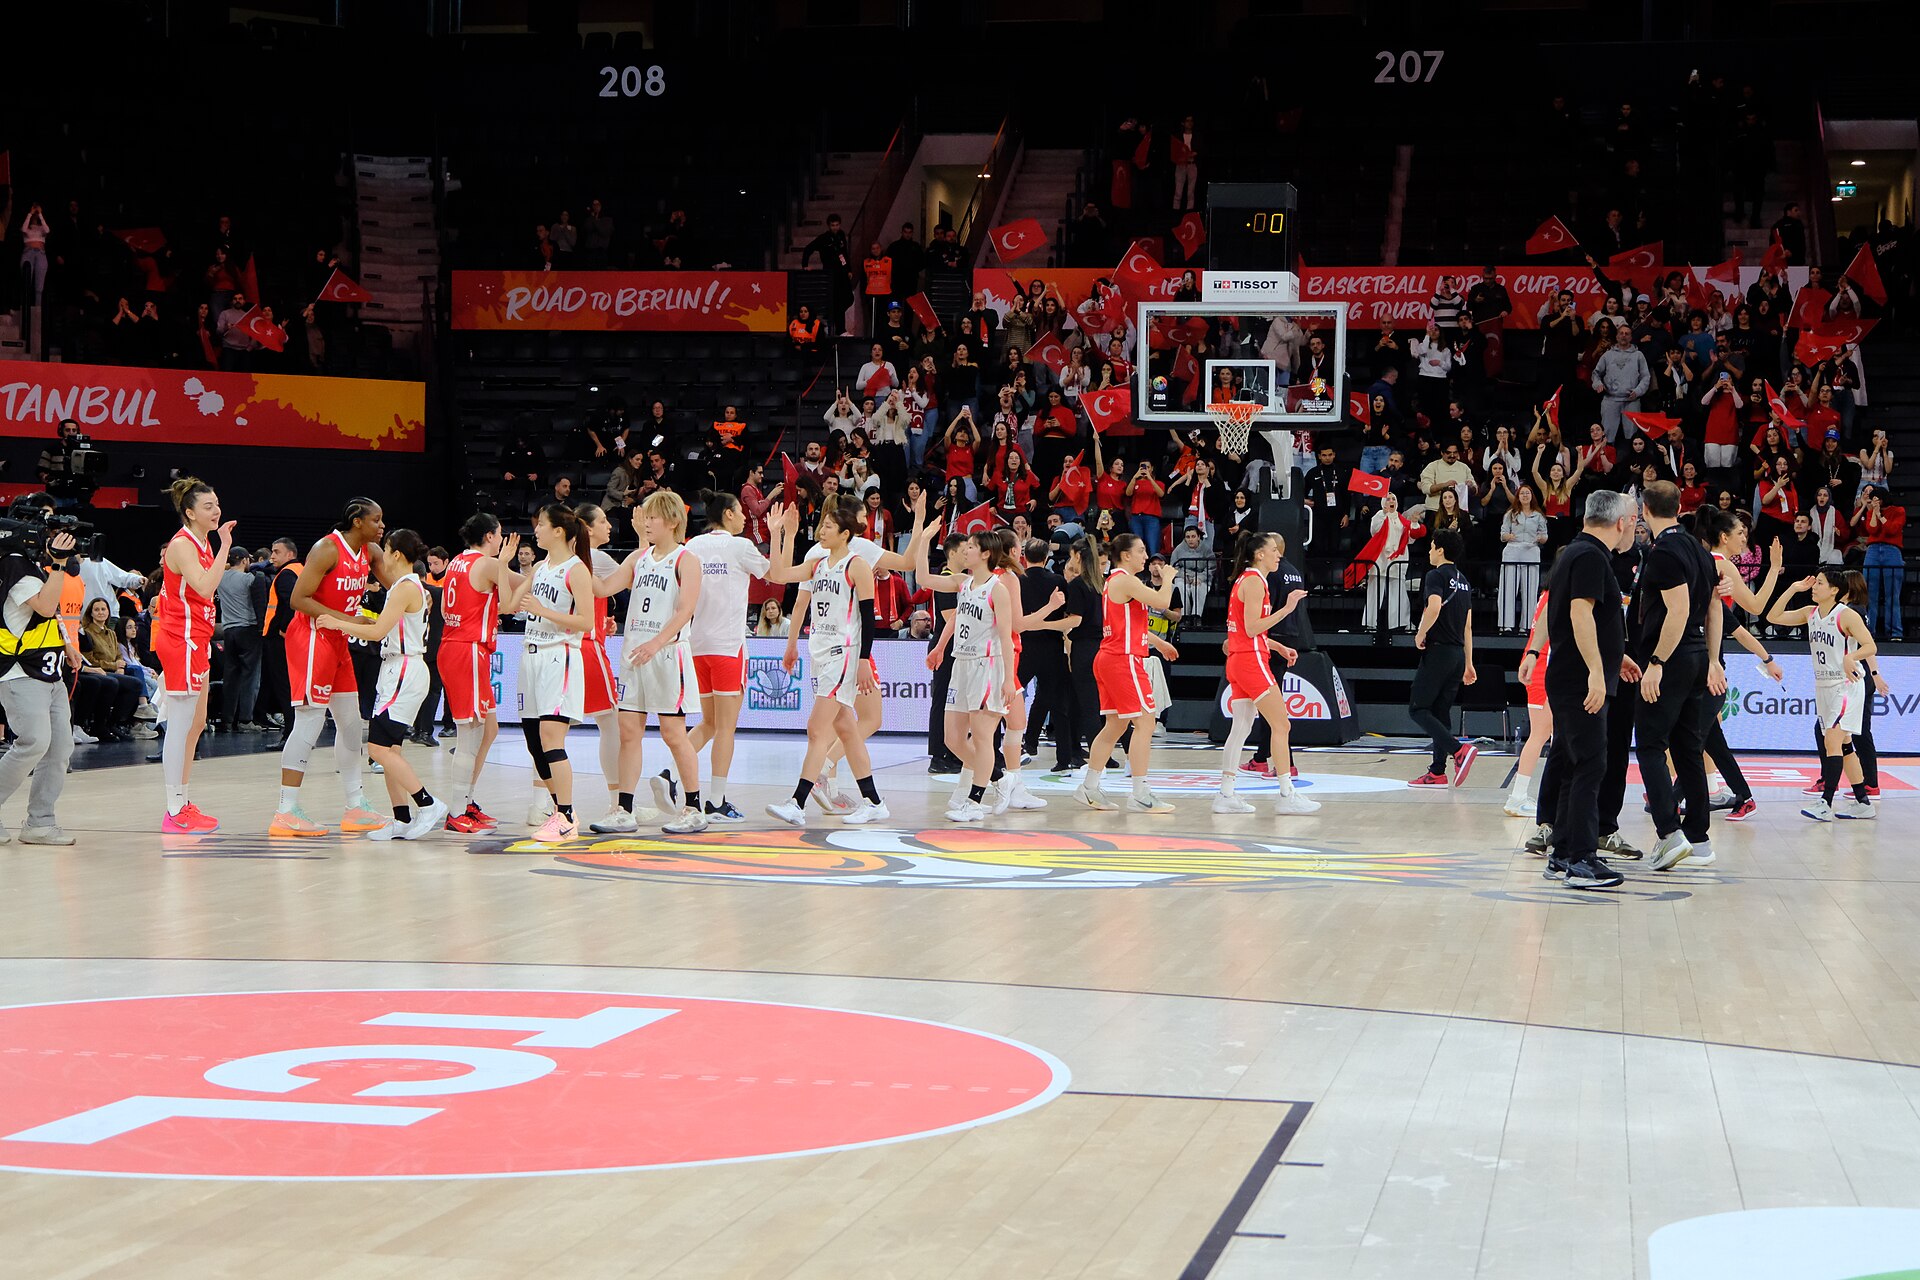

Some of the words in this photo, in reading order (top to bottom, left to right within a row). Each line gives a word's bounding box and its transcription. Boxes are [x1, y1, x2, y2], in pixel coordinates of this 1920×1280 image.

[1374, 50, 1445, 84] 207
[599, 65, 666, 98] 208
[1232, 280, 1278, 289] TISSOT
[1307, 275, 1427, 296] BASKETBALL
[1513, 274, 1559, 294] CUP
[1564, 276, 1608, 295] 202
[506, 285, 586, 321] ROAD
[590, 292, 611, 312] TO
[615, 280, 731, 316] BERLIN!!
[636, 573, 668, 592] JAPAN
[812, 578, 840, 596] JAPAN
[447, 577, 457, 608] 6
[532, 582, 559, 604] APAN
[345, 595, 361, 612] 22
[642, 597, 651, 613] 8
[817, 602, 830, 617] 52
[958, 602, 983, 621] JAPAN
[959, 624, 969, 639] 26
[1810, 630, 1835, 647] JAPAN
[1816, 651, 1826, 665] 13
[881, 680, 934, 698] arant
[1743, 690, 1817, 715] Garan
